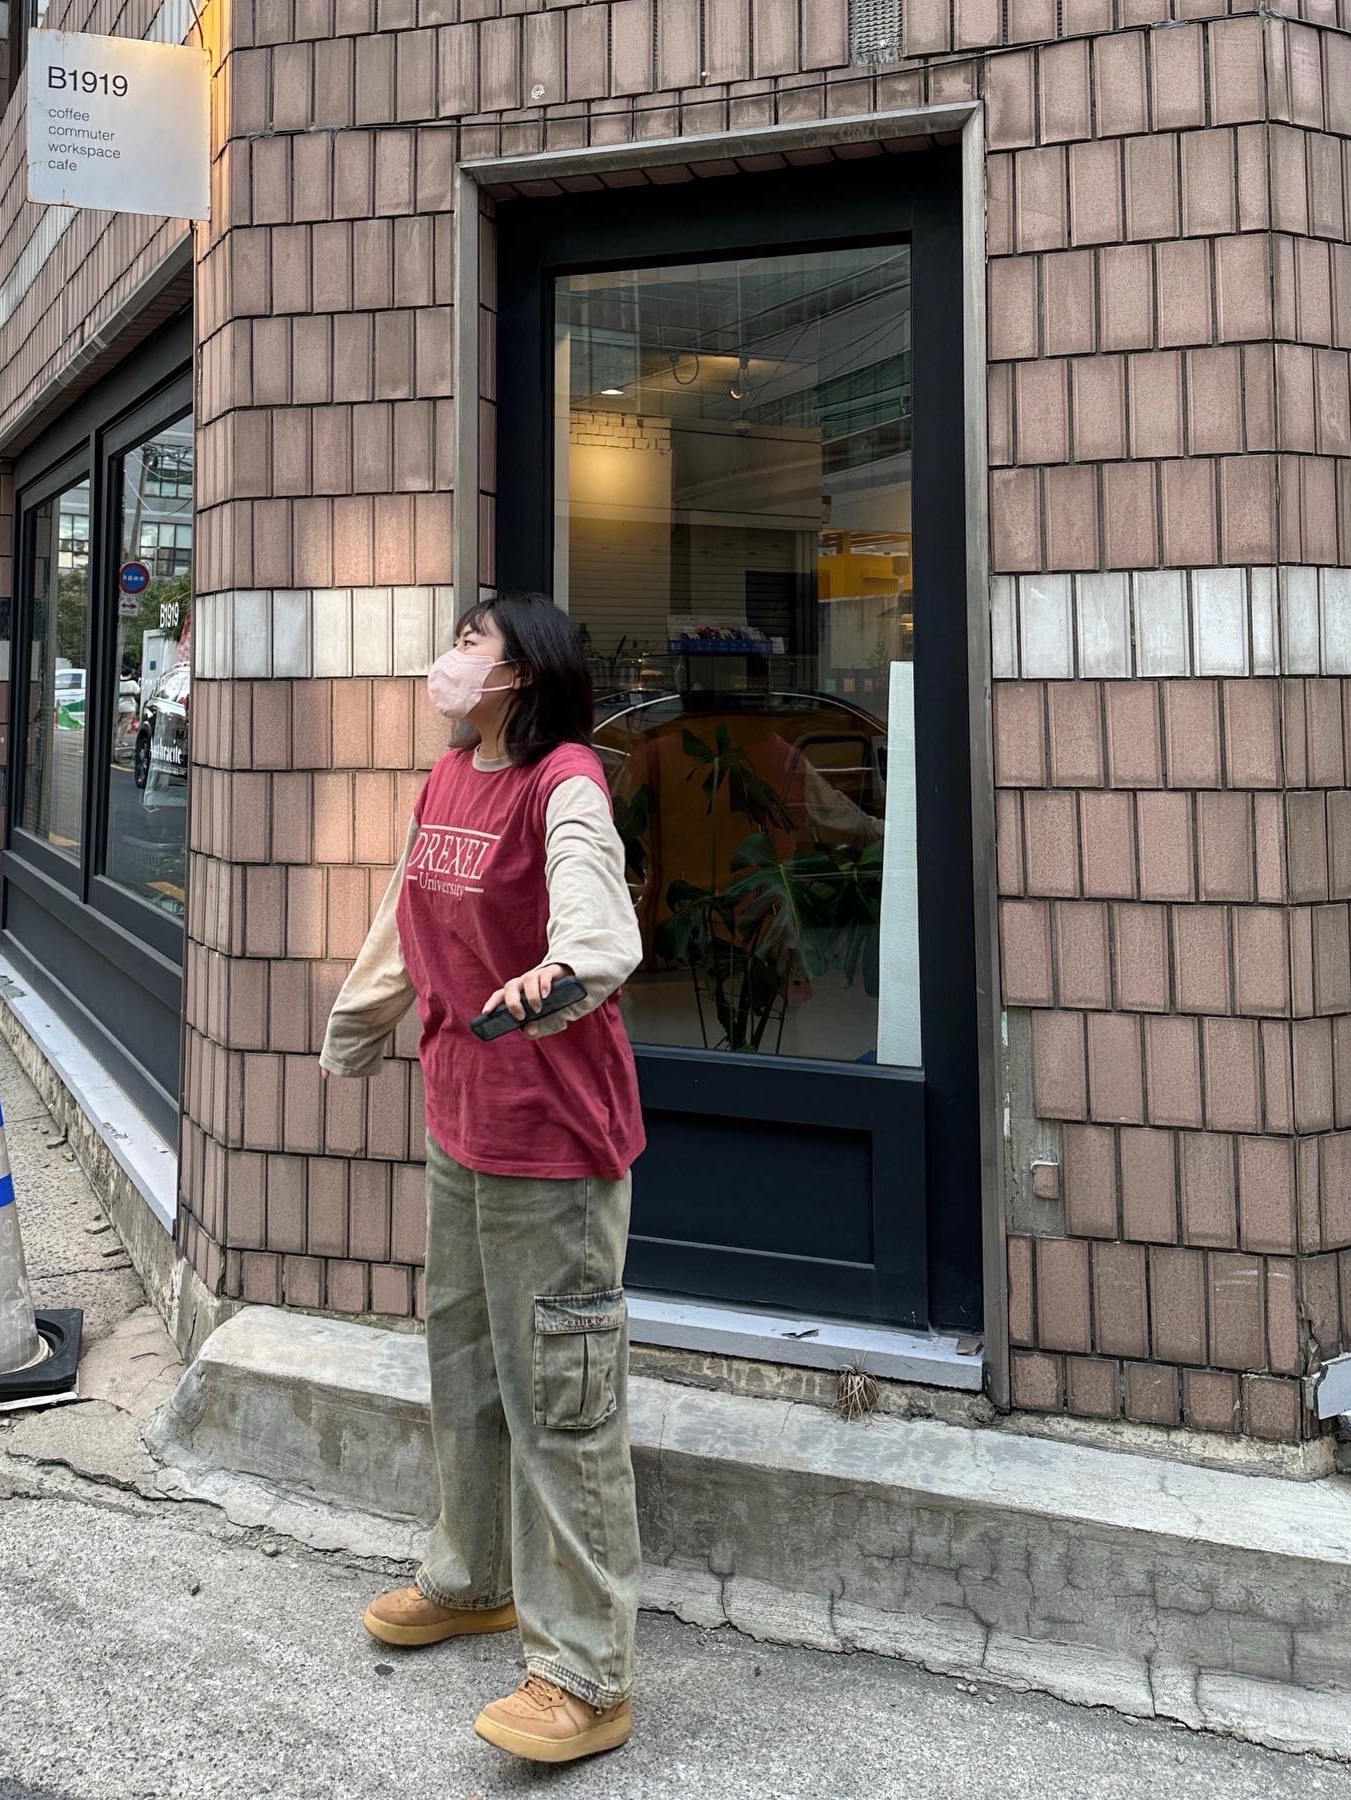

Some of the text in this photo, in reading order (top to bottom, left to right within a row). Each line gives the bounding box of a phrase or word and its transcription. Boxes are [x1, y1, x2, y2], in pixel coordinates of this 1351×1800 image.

[48, 66, 128, 97] B1919
[48, 107, 90, 121] coffee
[48, 125, 115, 141] commuter
[48, 143, 121, 159] workspace
[48, 159, 77, 171] cafe
[160, 600, 180, 628] B1919
[406, 832, 490, 880] DREXEL
[419, 871, 465, 900] University
